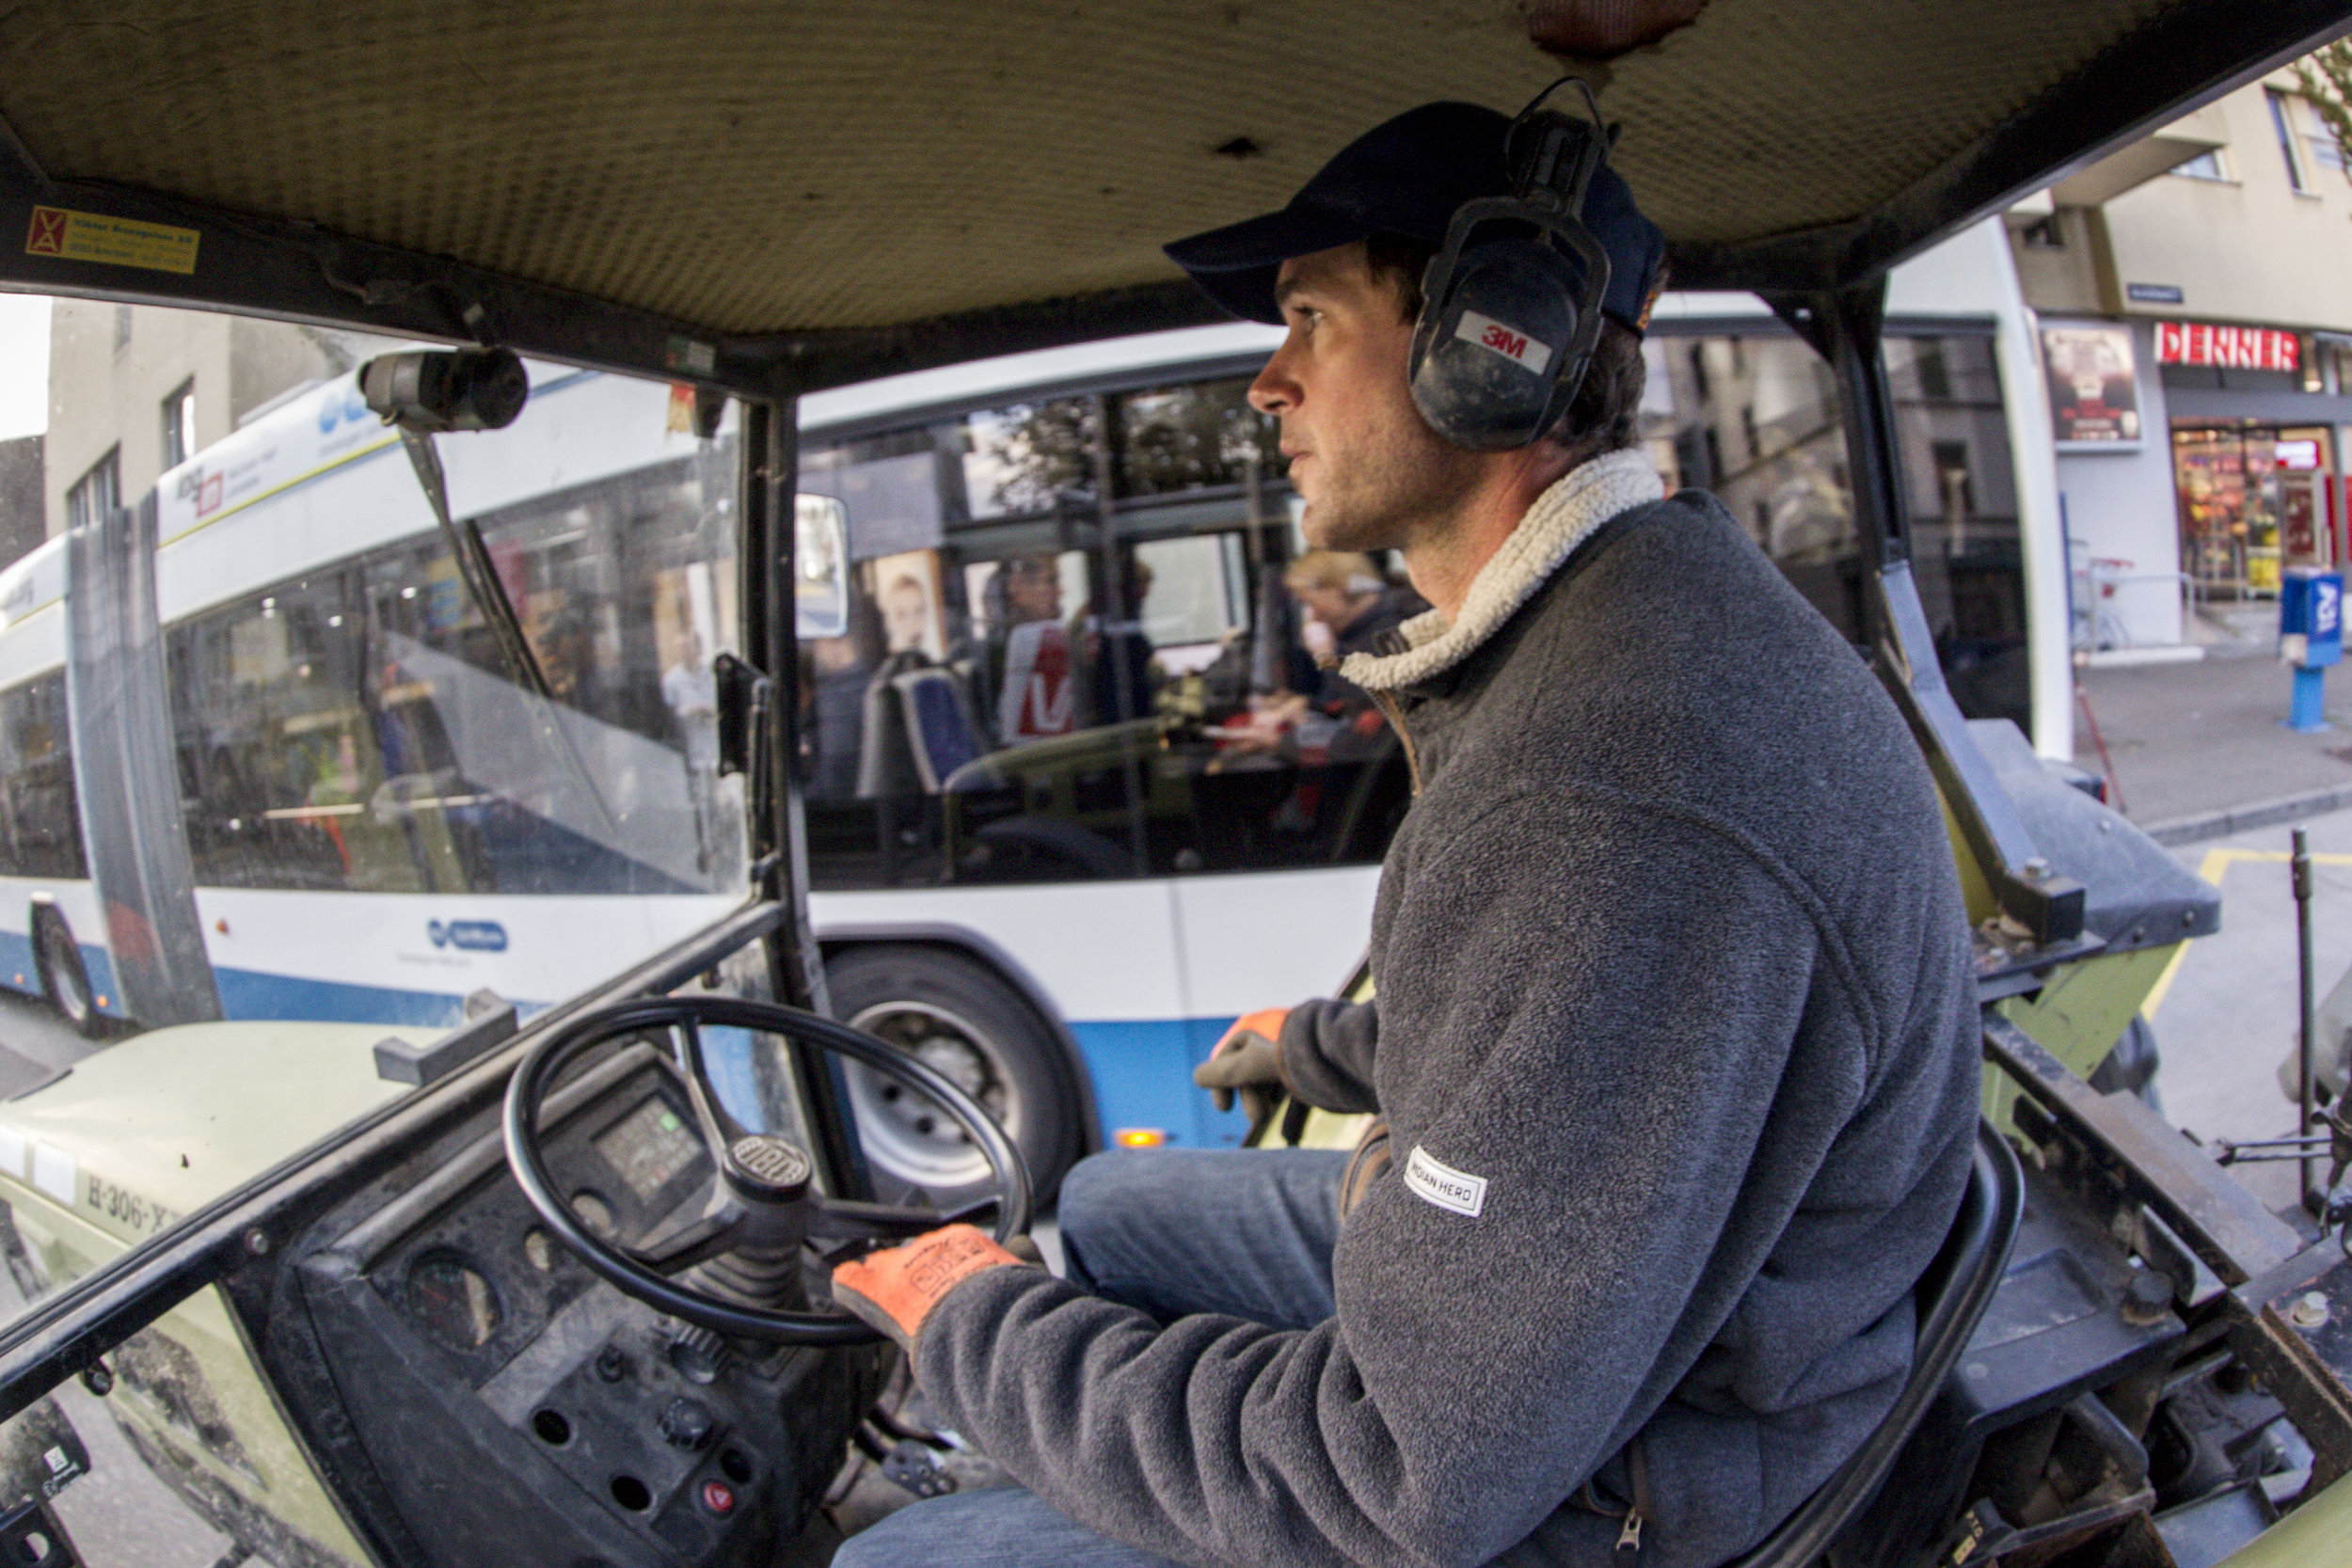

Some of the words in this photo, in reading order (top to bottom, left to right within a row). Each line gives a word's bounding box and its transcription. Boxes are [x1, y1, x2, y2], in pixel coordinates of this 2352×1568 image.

[1482, 325, 1528, 359] 3M
[2157, 322, 2300, 372] DENNER
[1438, 1180, 1472, 1201] HERO
